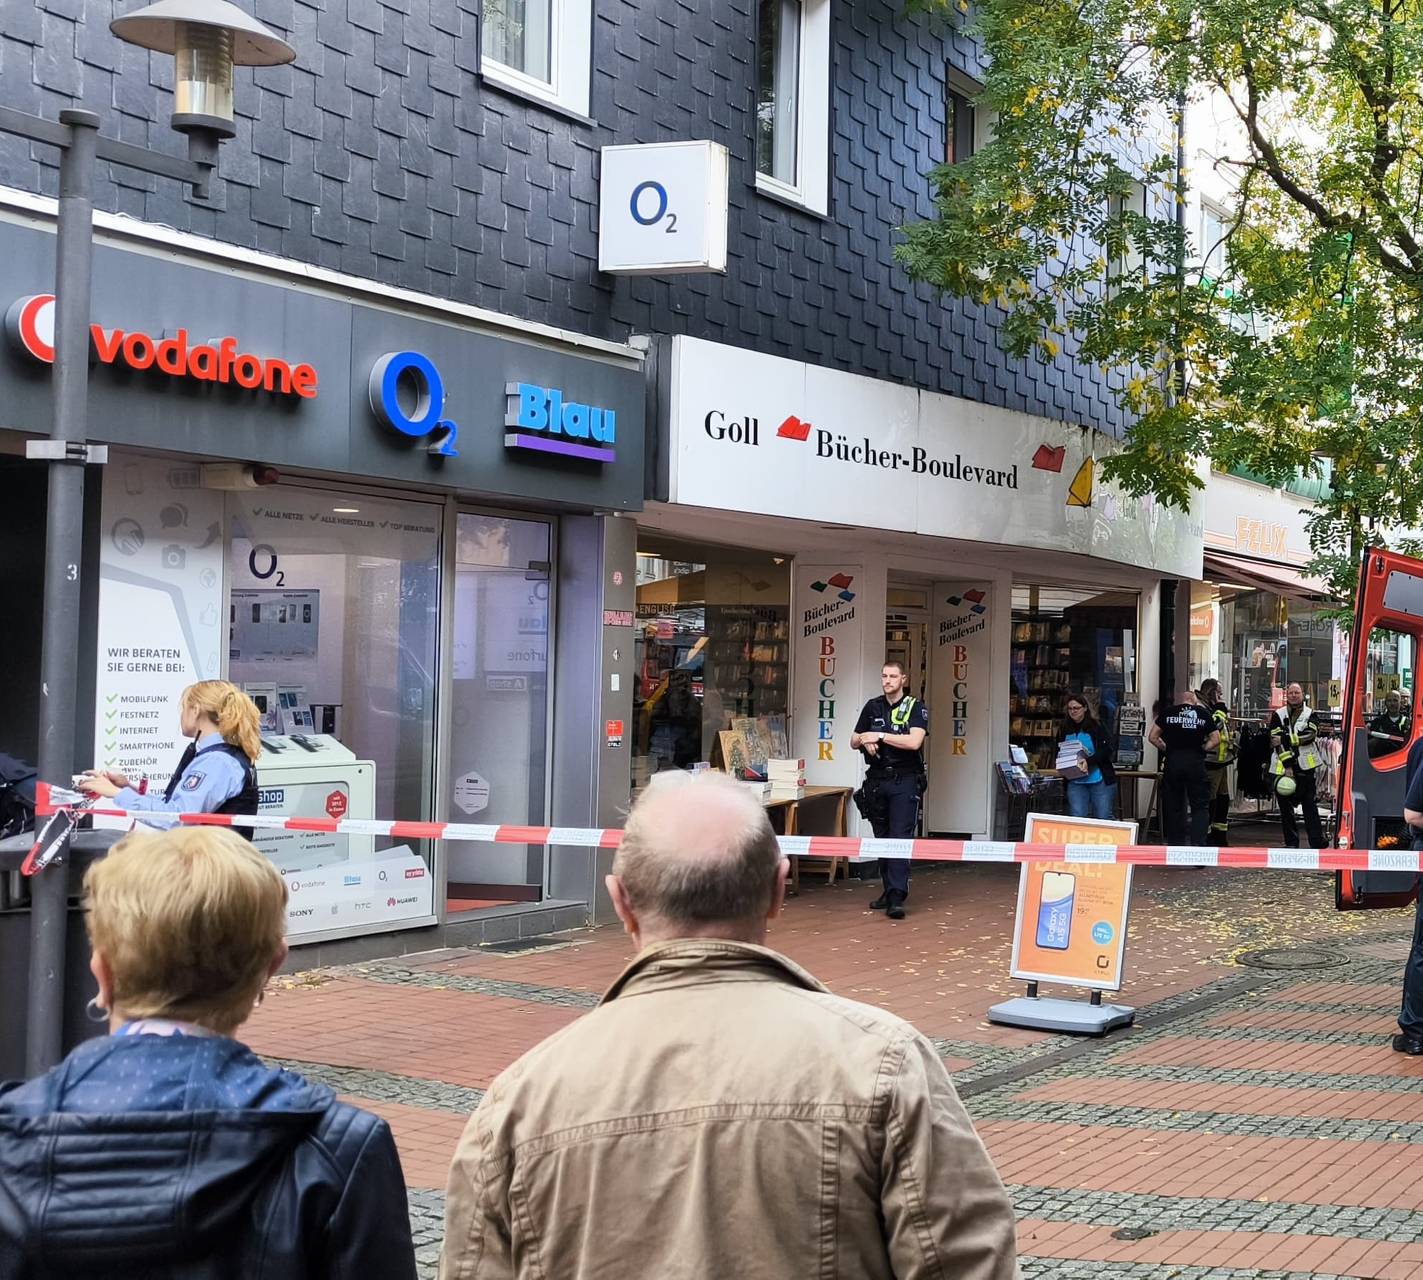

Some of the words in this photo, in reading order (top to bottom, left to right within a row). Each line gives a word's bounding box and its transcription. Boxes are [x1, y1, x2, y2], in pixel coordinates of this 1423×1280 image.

[89, 323, 319, 398] vodafone
[514, 382, 616, 443] Blau
[704, 409, 760, 446] Goll
[816, 428, 1019, 490] Bücher-Boulevard
[1235, 514, 1289, 559] FELIX
[66, 564, 78, 581] 3
[803, 607, 856, 638] Boulevard
[804, 600, 846, 624] Bücher-
[939, 613, 978, 634] Bücher-
[939, 619, 986, 646] Boulevard
[108, 647, 130, 658] WIR
[132, 648, 181, 659] BERATEN
[107, 662, 124, 672] SIE
[126, 662, 163, 673] GERNE
[165, 663, 185, 673] BEI:
[121, 695, 169, 704] MOBILFUNK
[817, 636, 836, 761] BÜCHER
[952, 645, 968, 756] BÜCHER
[120, 711, 160, 719] FESTNETZ
[120, 727, 159, 735] INTERNET
[119, 742, 175, 751] SMARTPHONE
[118, 756, 158, 767] ZUBEHÖR
[289, 909, 314, 918] SONY
